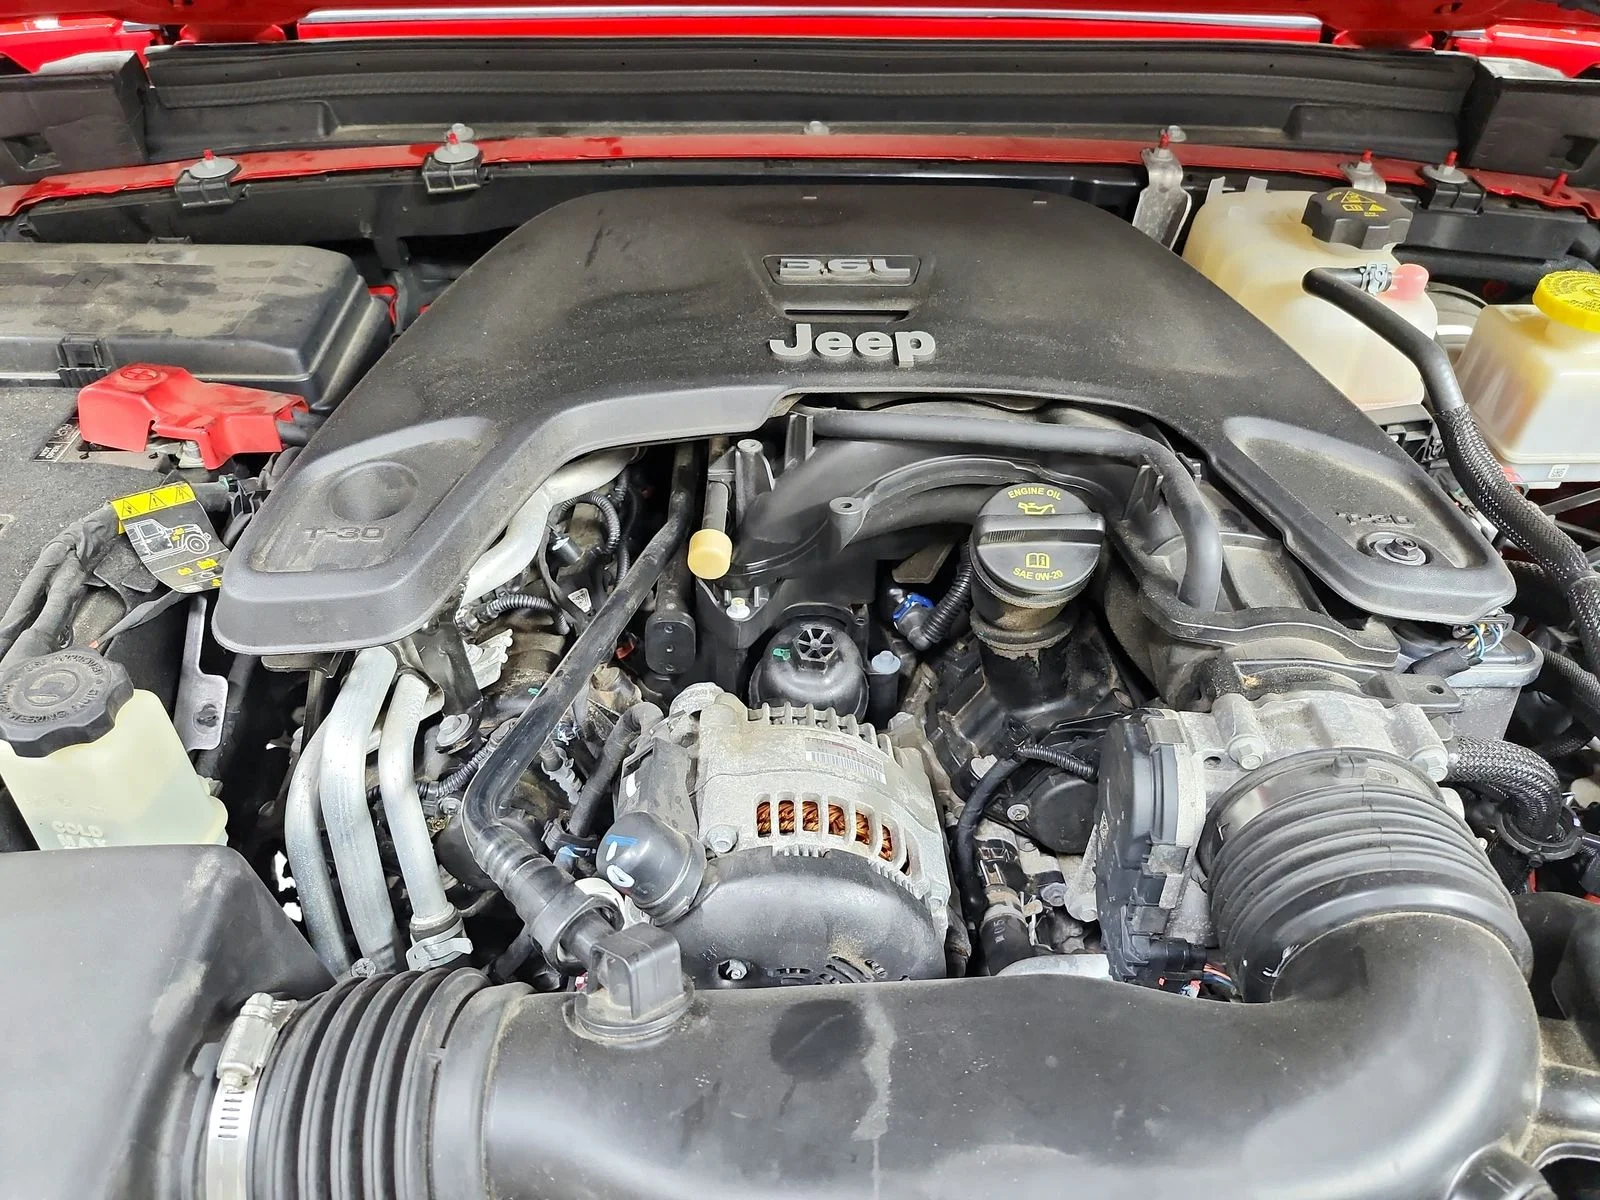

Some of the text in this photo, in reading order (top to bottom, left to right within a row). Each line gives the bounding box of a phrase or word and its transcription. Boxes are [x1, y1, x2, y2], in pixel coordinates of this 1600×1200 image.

[779, 257, 911, 278] 3.6L
[769, 323, 936, 368] Jeep
[1007, 487, 1062, 501] ENGINE OIL
[303, 527, 385, 541] T-30
[1012, 567, 1064, 581] SAE 0W-20
[52, 820, 104, 838] COLD
